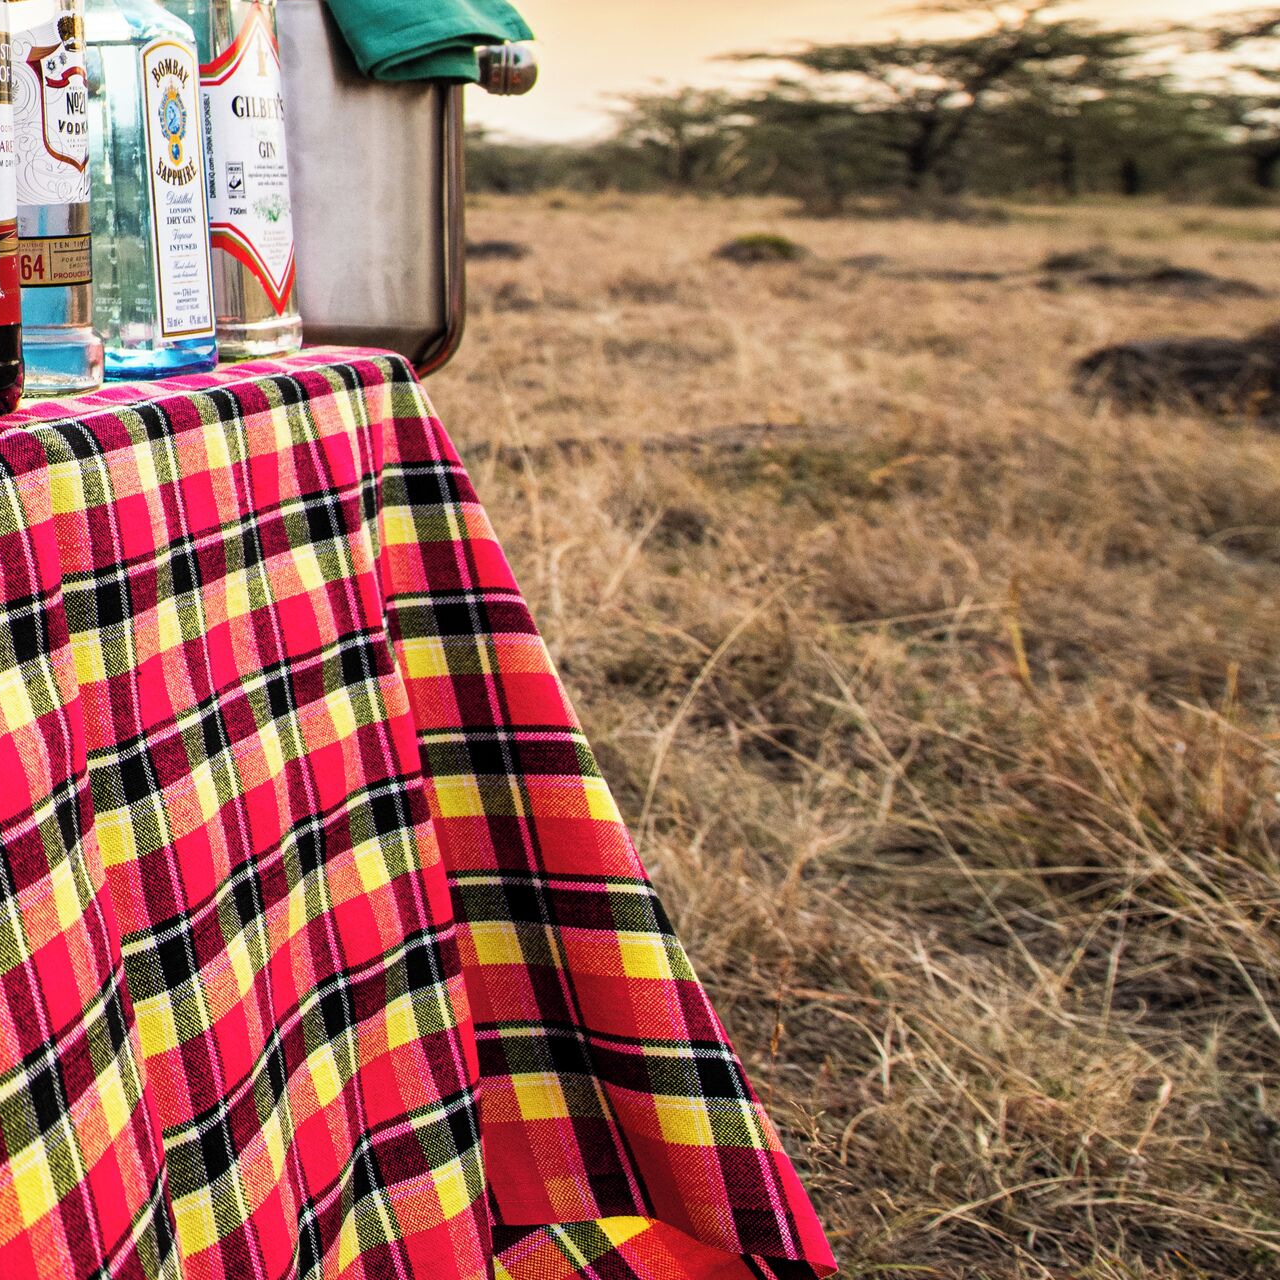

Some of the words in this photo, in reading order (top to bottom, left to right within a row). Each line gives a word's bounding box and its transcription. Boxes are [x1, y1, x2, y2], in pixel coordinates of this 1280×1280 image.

[152, 58, 189, 89] BOMBAY
[258, 141, 277, 159] GIN
[156, 157, 198, 186] SAPPHIRE
[166, 216, 182, 225] DRY
[183, 216, 196, 224] GIN
[169, 243, 198, 252] INFUSED
[21, 254, 45, 280] 64
